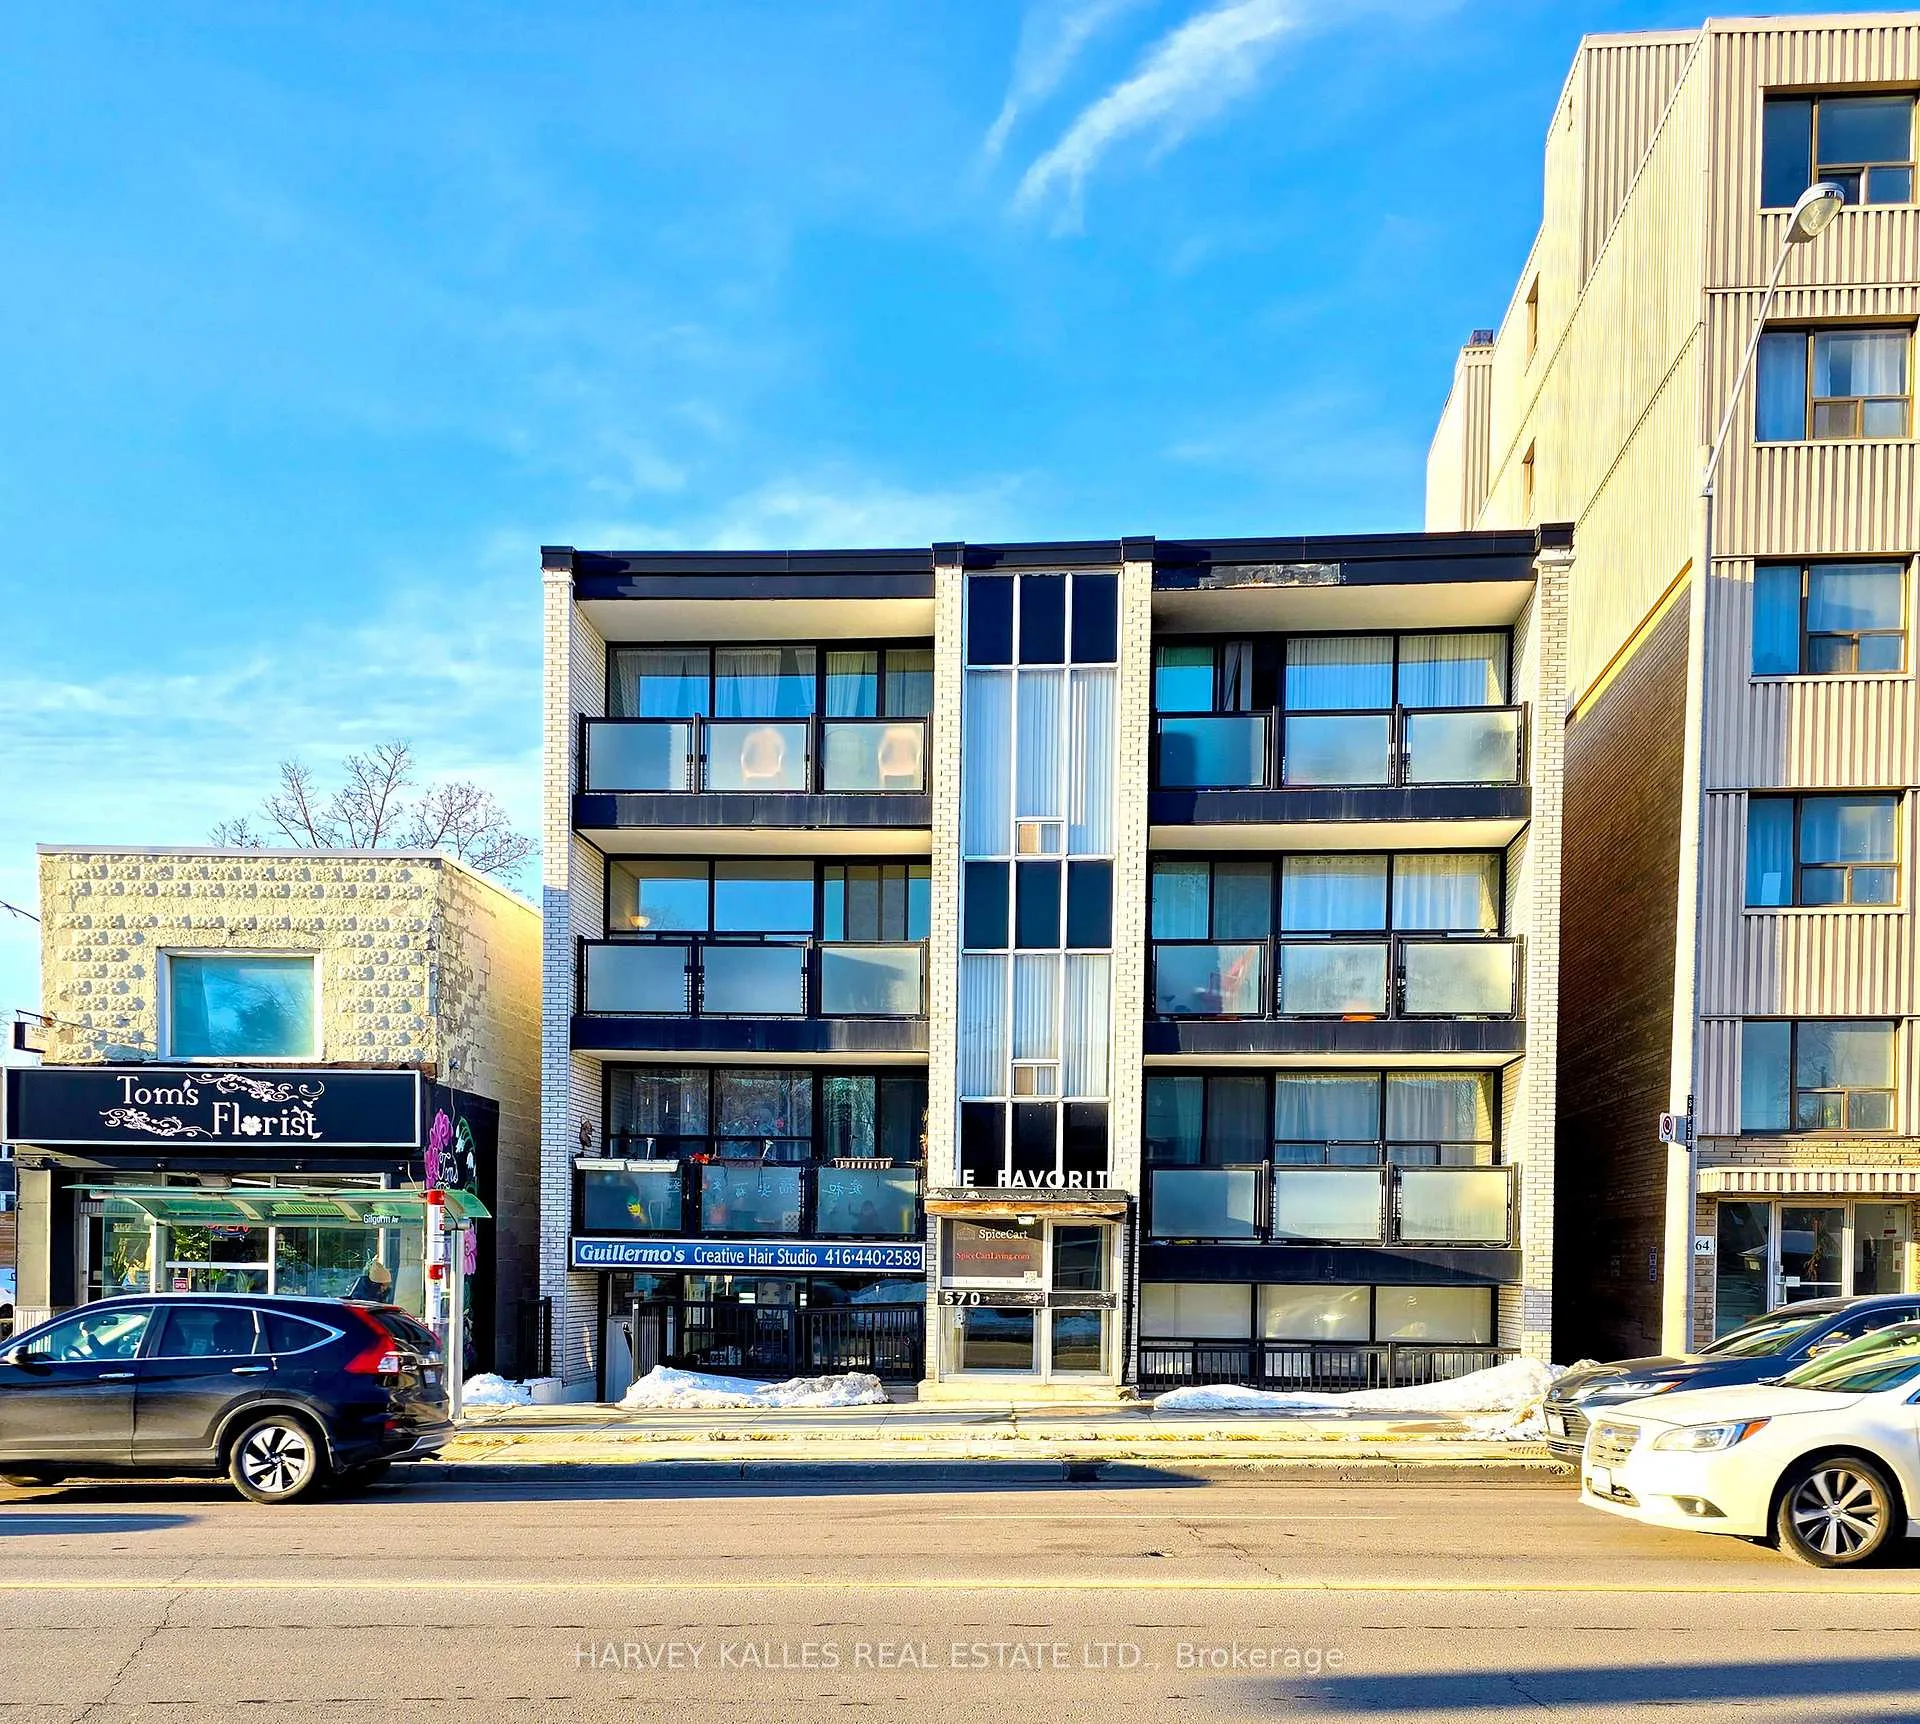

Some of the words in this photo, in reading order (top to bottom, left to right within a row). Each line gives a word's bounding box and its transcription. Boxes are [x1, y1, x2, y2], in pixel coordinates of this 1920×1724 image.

[117, 1075, 199, 1106] Tom's
[212, 1102, 323, 1140] Florist
[997, 1169, 1110, 1189] FAVORIT
[979, 1229, 1028, 1241] SpiceCart
[580, 1243, 685, 1263] Guillermo's
[694, 1247, 744, 1264] Creative
[749, 1247, 774, 1265] Hair
[777, 1248, 817, 1266] Studio
[944, 1291, 980, 1305] 570
